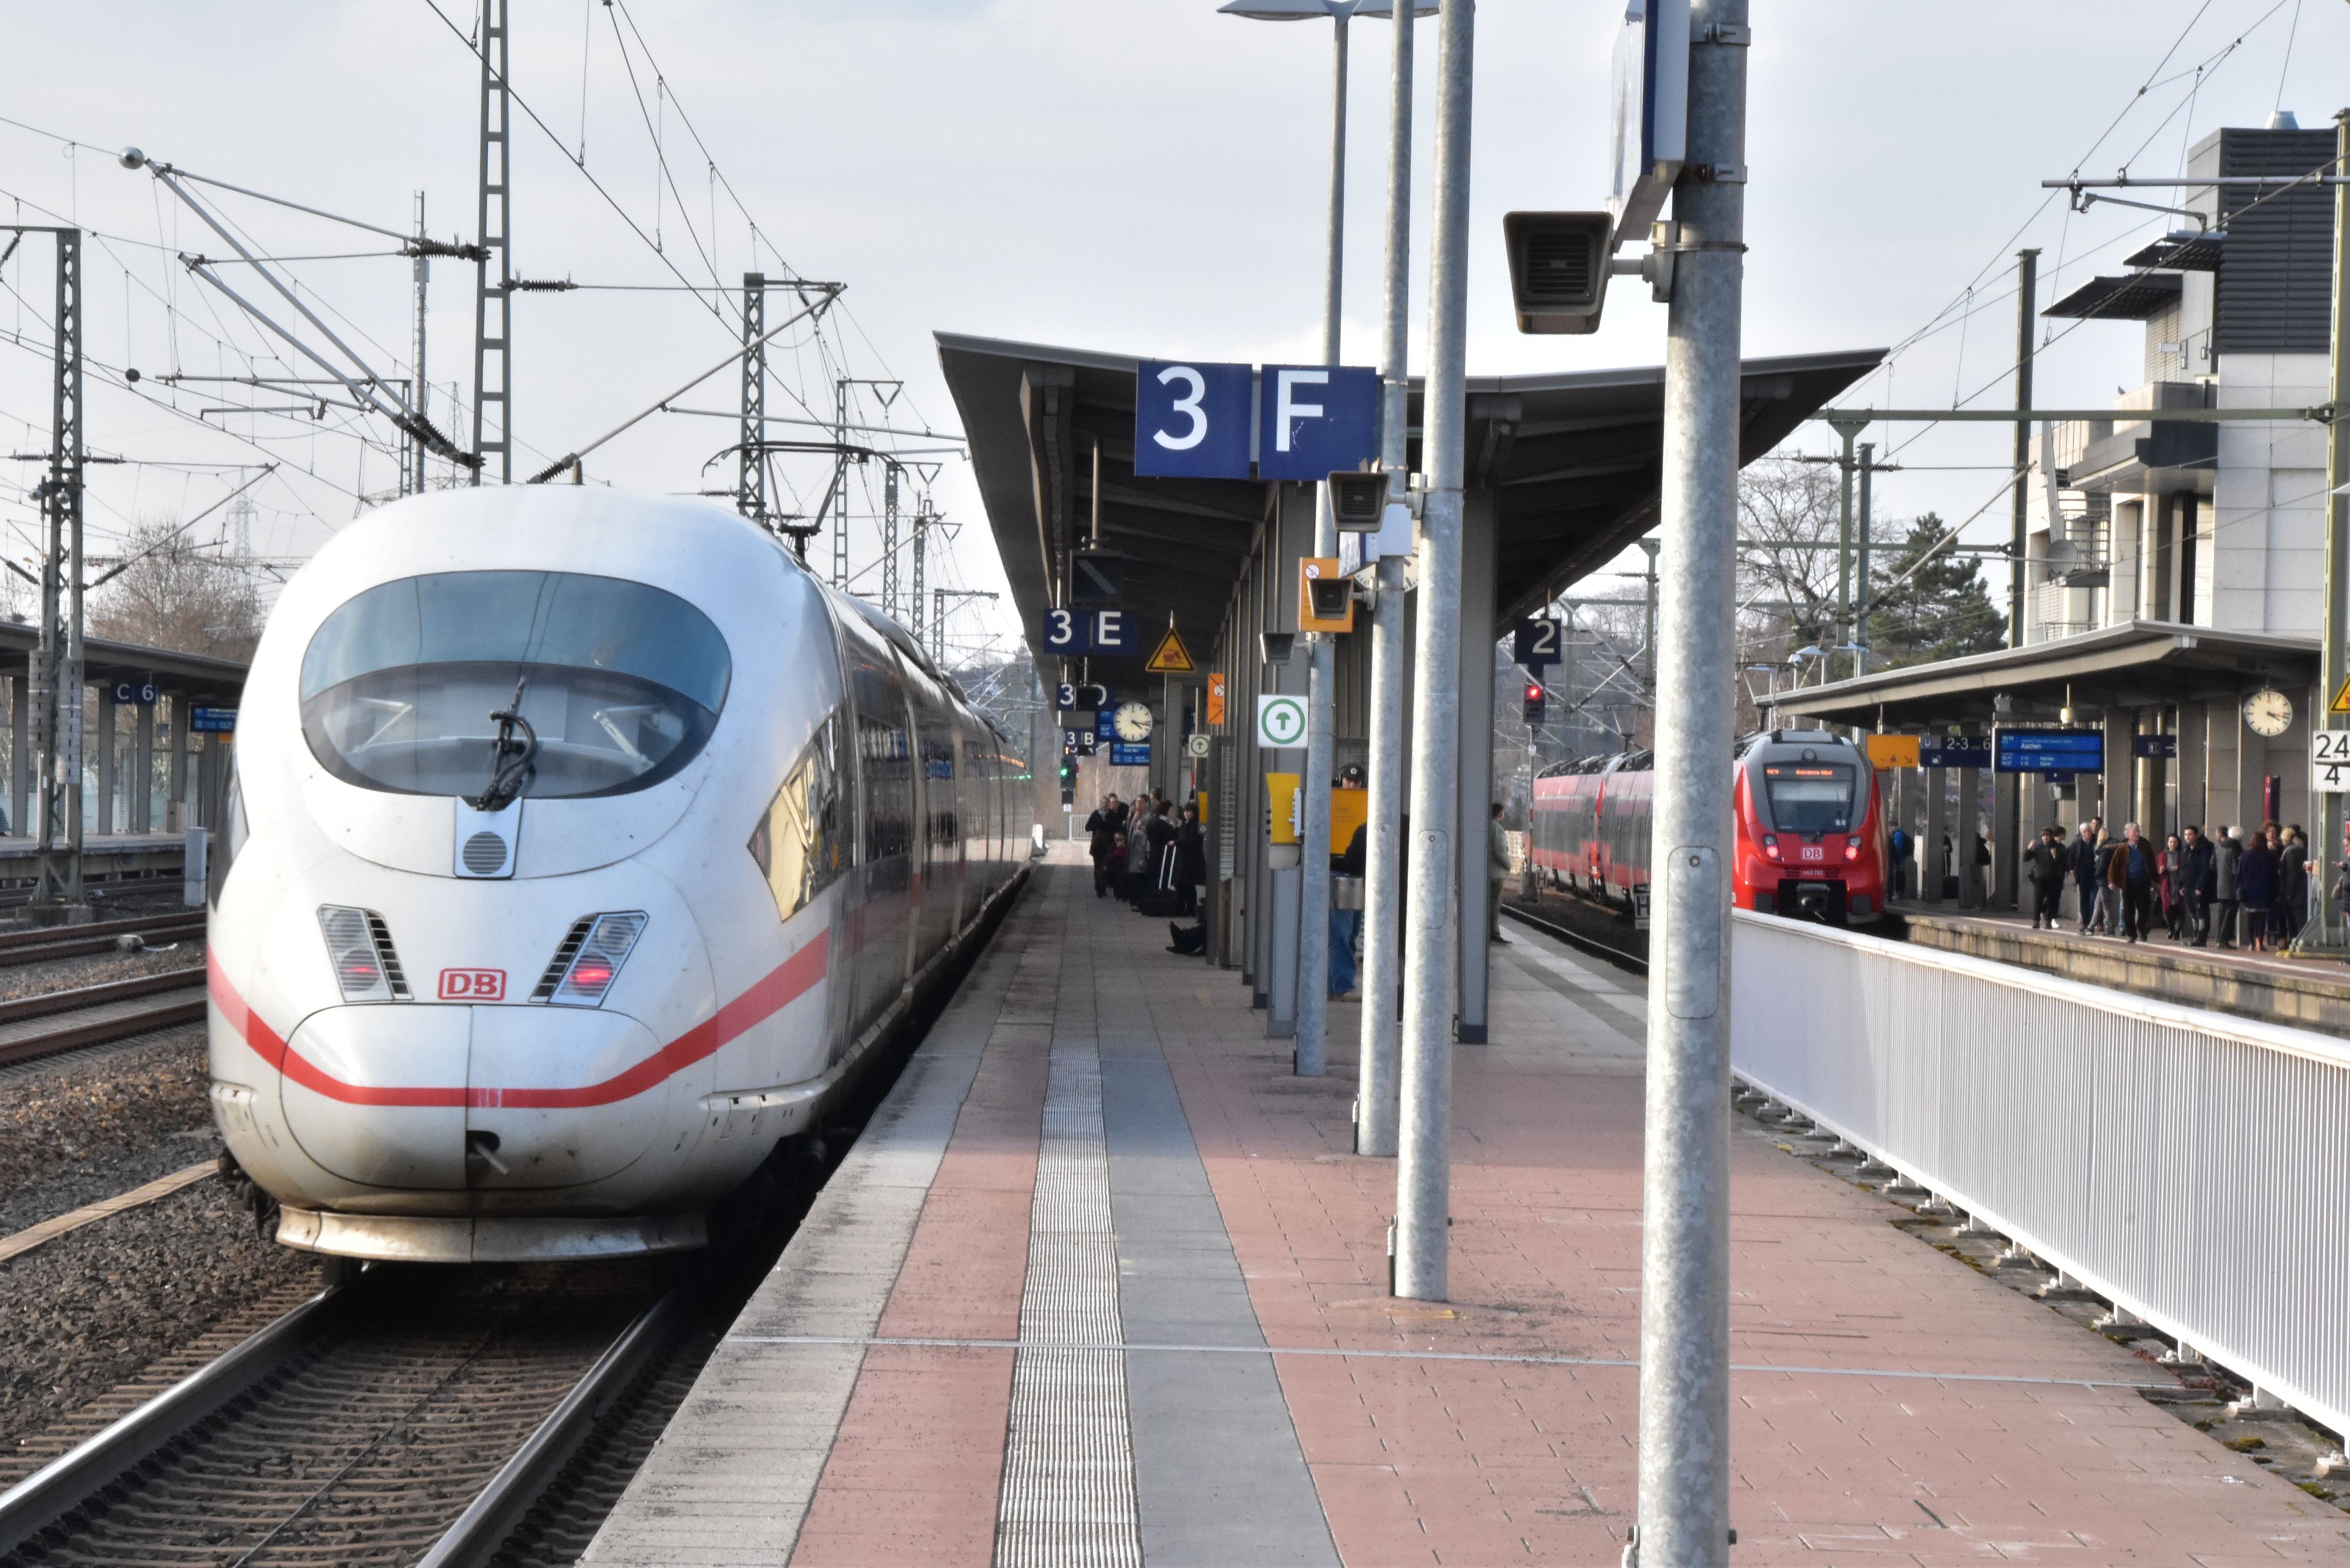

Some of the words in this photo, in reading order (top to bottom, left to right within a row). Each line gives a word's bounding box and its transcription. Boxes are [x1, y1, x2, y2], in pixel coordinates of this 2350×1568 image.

[1152, 365, 1208, 451] 3
[1275, 369, 1330, 452] F
[1049, 609, 1072, 644] 3
[1098, 610, 1122, 645] E
[1532, 619, 1555, 654] 2
[117, 684, 130, 700] C
[142, 684, 154, 701] 6
[1060, 683, 1074, 705] 3
[1067, 731, 1076, 745] 3
[1084, 732, 1094, 746] B
[1946, 737, 1969, 750] 2-3
[1983, 737, 1992, 750] 6
[2315, 734, 2349, 758] 24
[2324, 764, 2341, 785] 4
[1803, 848, 1822, 859] DB
[1636, 895, 1650, 916] H
[445, 971, 499, 996] DB
